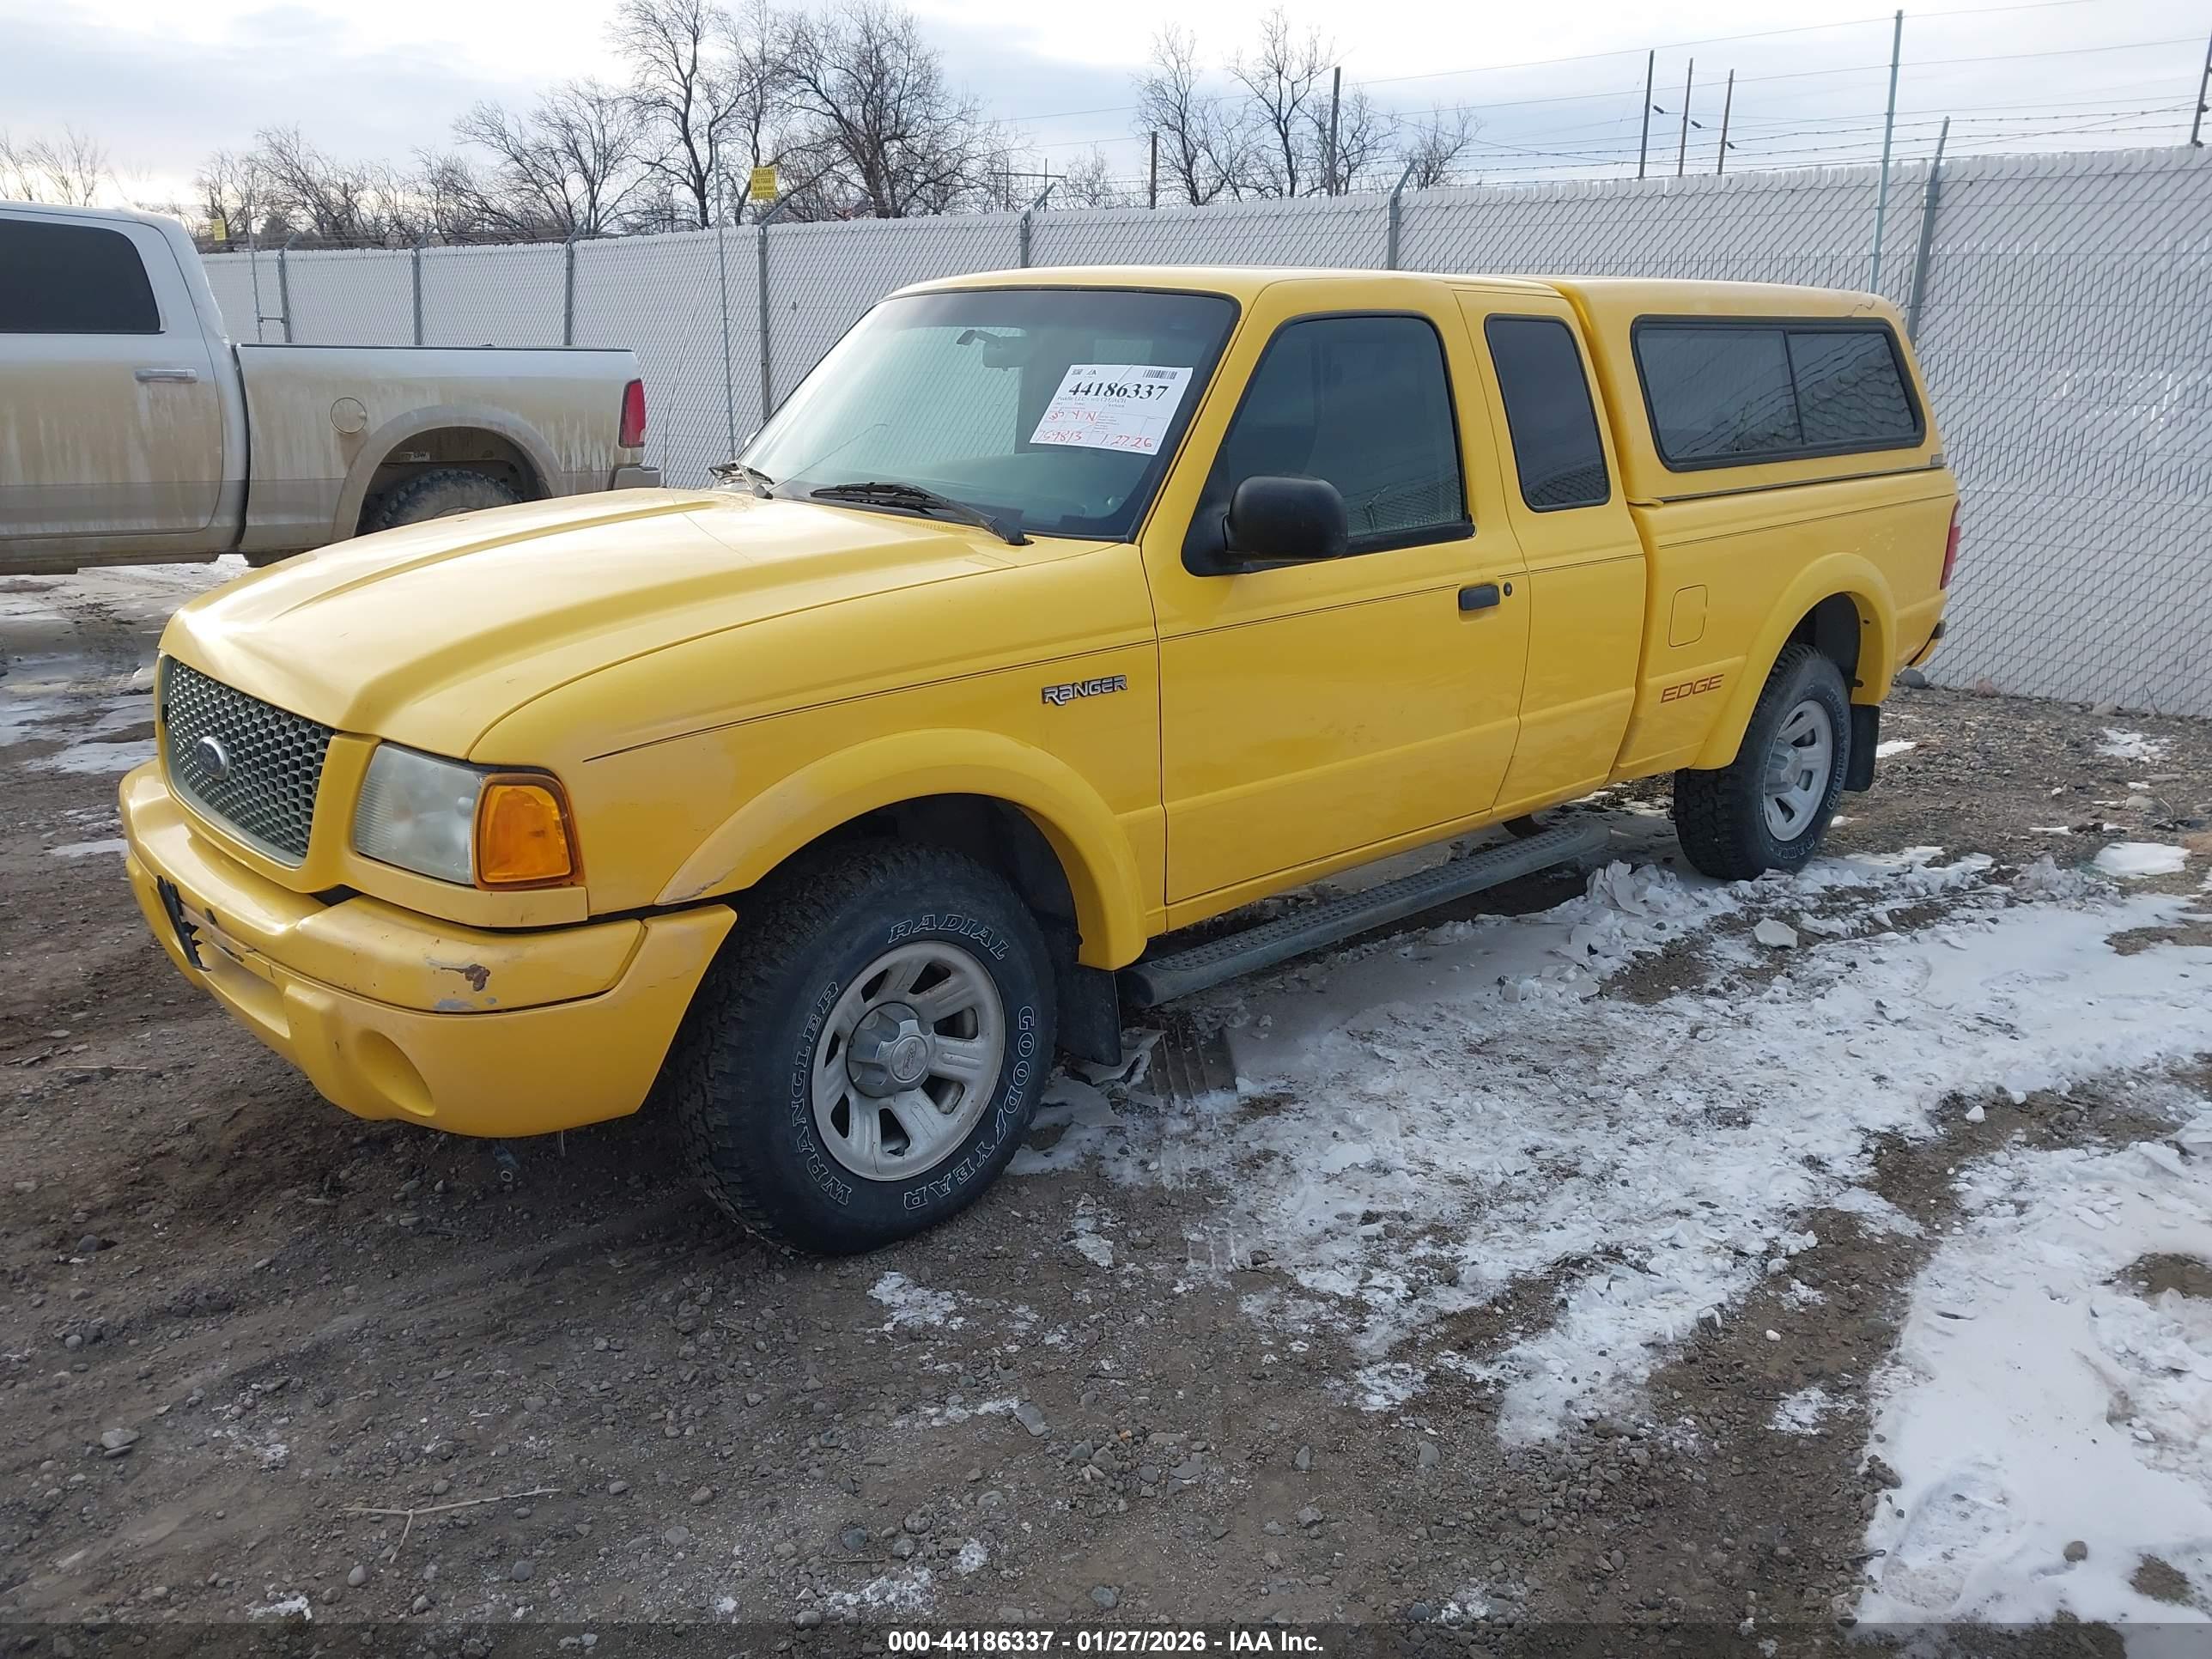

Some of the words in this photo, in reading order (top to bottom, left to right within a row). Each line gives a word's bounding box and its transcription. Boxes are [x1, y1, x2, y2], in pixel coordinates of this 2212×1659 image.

[1068, 381, 1170, 401] 44186337
[1042, 674, 1127, 706] RANGER
[1660, 673, 1725, 704] EDGE
[887, 914, 1010, 961] RADIAL
[791, 981, 853, 1206] WRANGLER
